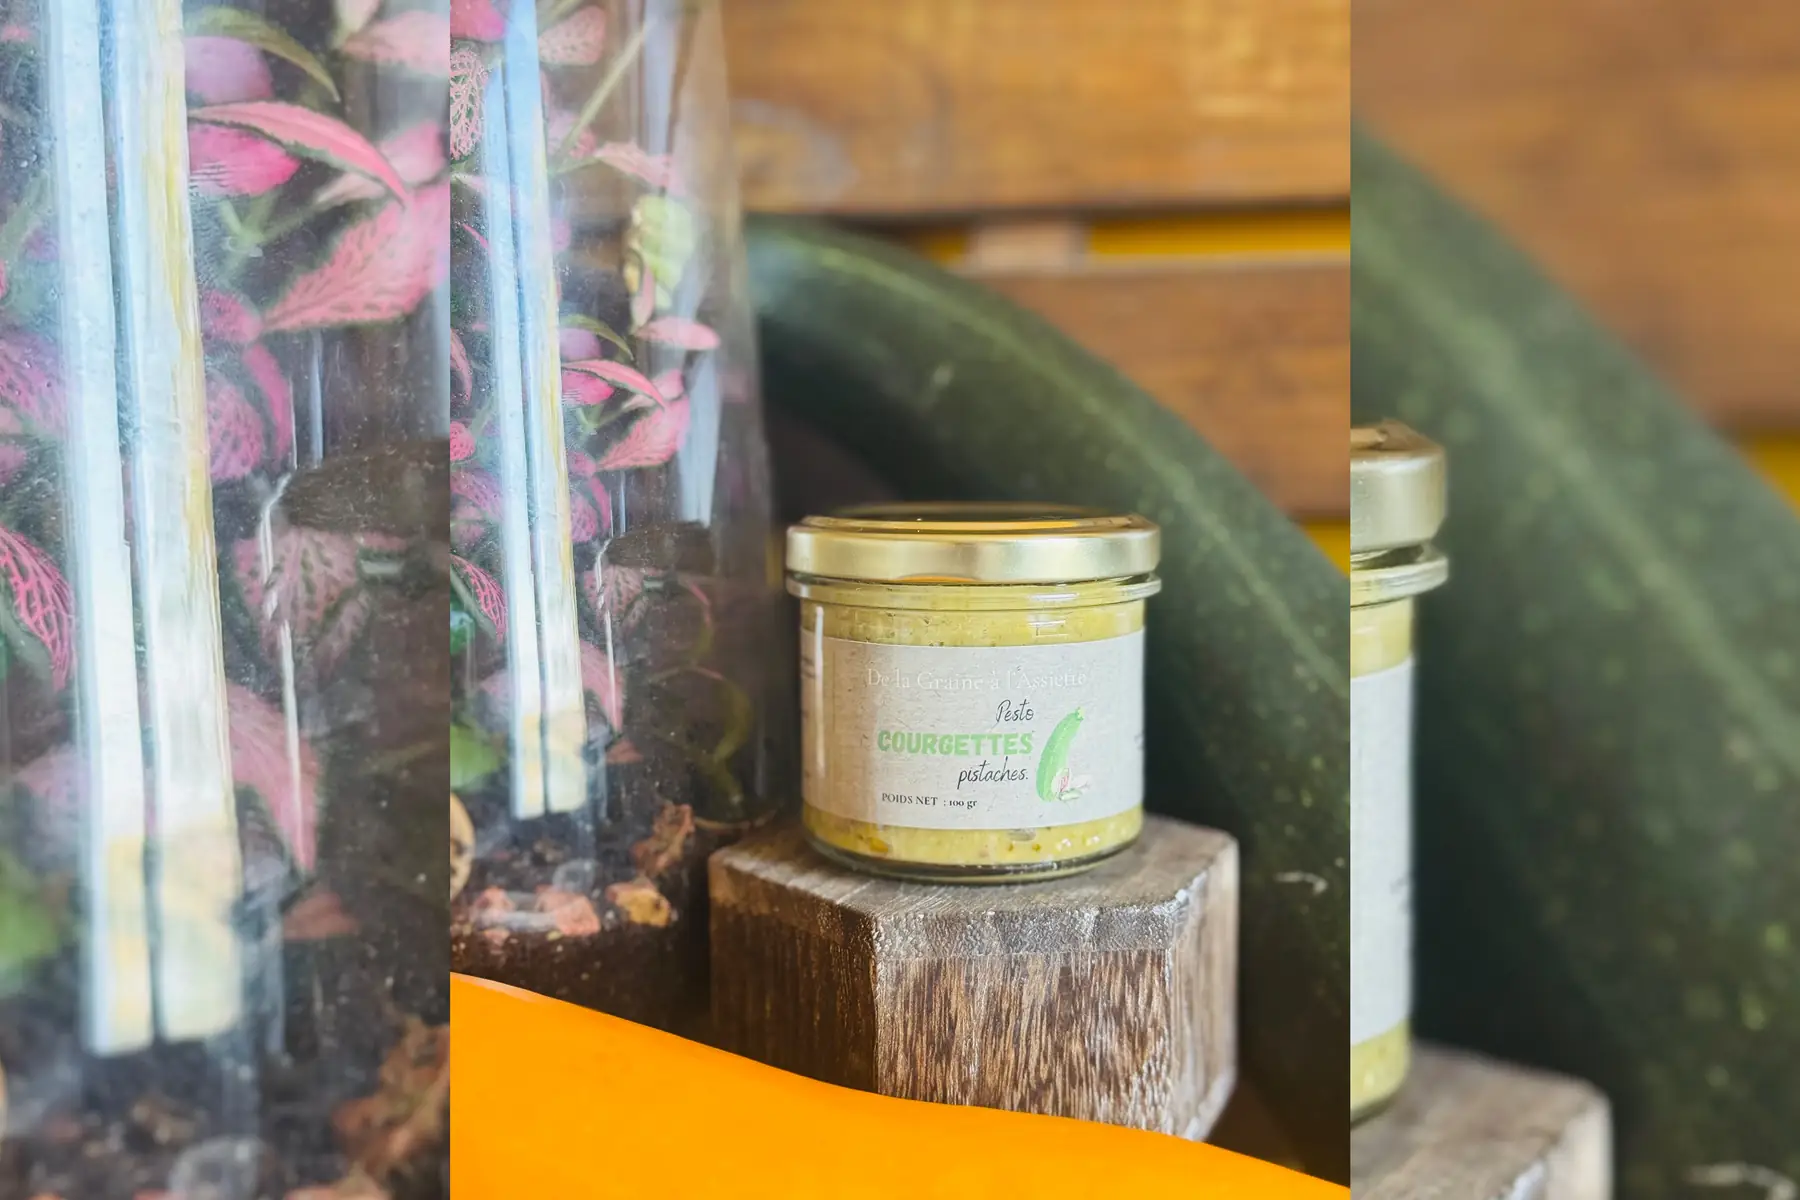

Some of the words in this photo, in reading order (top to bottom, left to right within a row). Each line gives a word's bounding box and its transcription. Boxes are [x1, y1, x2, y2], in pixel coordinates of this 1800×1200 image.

[868, 669, 890, 688] De
[894, 669, 910, 688] la
[917, 671, 984, 690] Graine
[991, 671, 999, 689] à
[996, 698, 1034, 723] Pesto
[877, 730, 1035, 756] COURGETTES
[957, 756, 1028, 790] pistaches.
[881, 793, 913, 804] POIDS
[915, 795, 938, 806] NET
